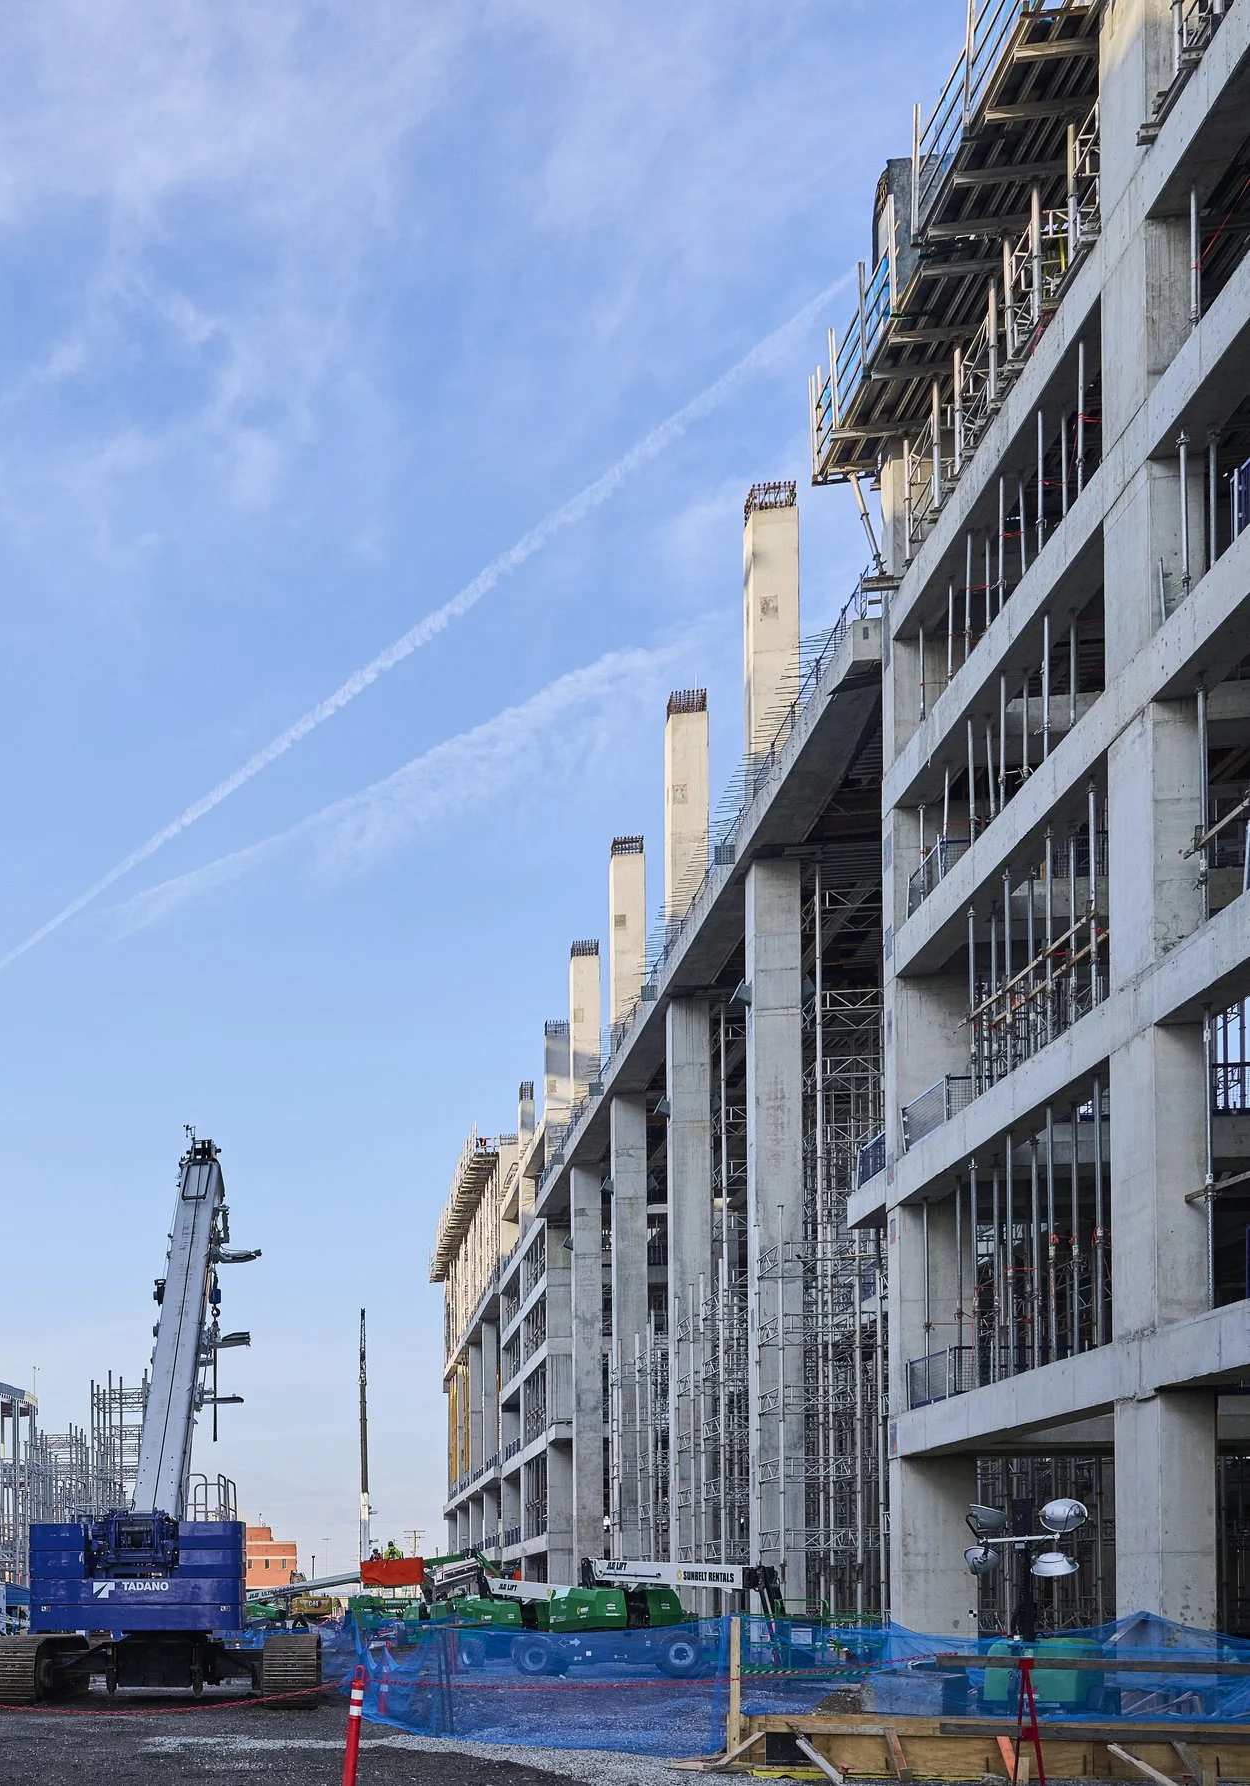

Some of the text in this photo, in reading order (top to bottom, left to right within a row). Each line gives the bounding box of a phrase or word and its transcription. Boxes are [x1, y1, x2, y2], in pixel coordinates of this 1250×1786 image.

[616, 1562, 627, 1570] LIFT
[683, 1571, 734, 1583] SUNBELT RENTALS
[122, 1581, 169, 1590] TADANO
